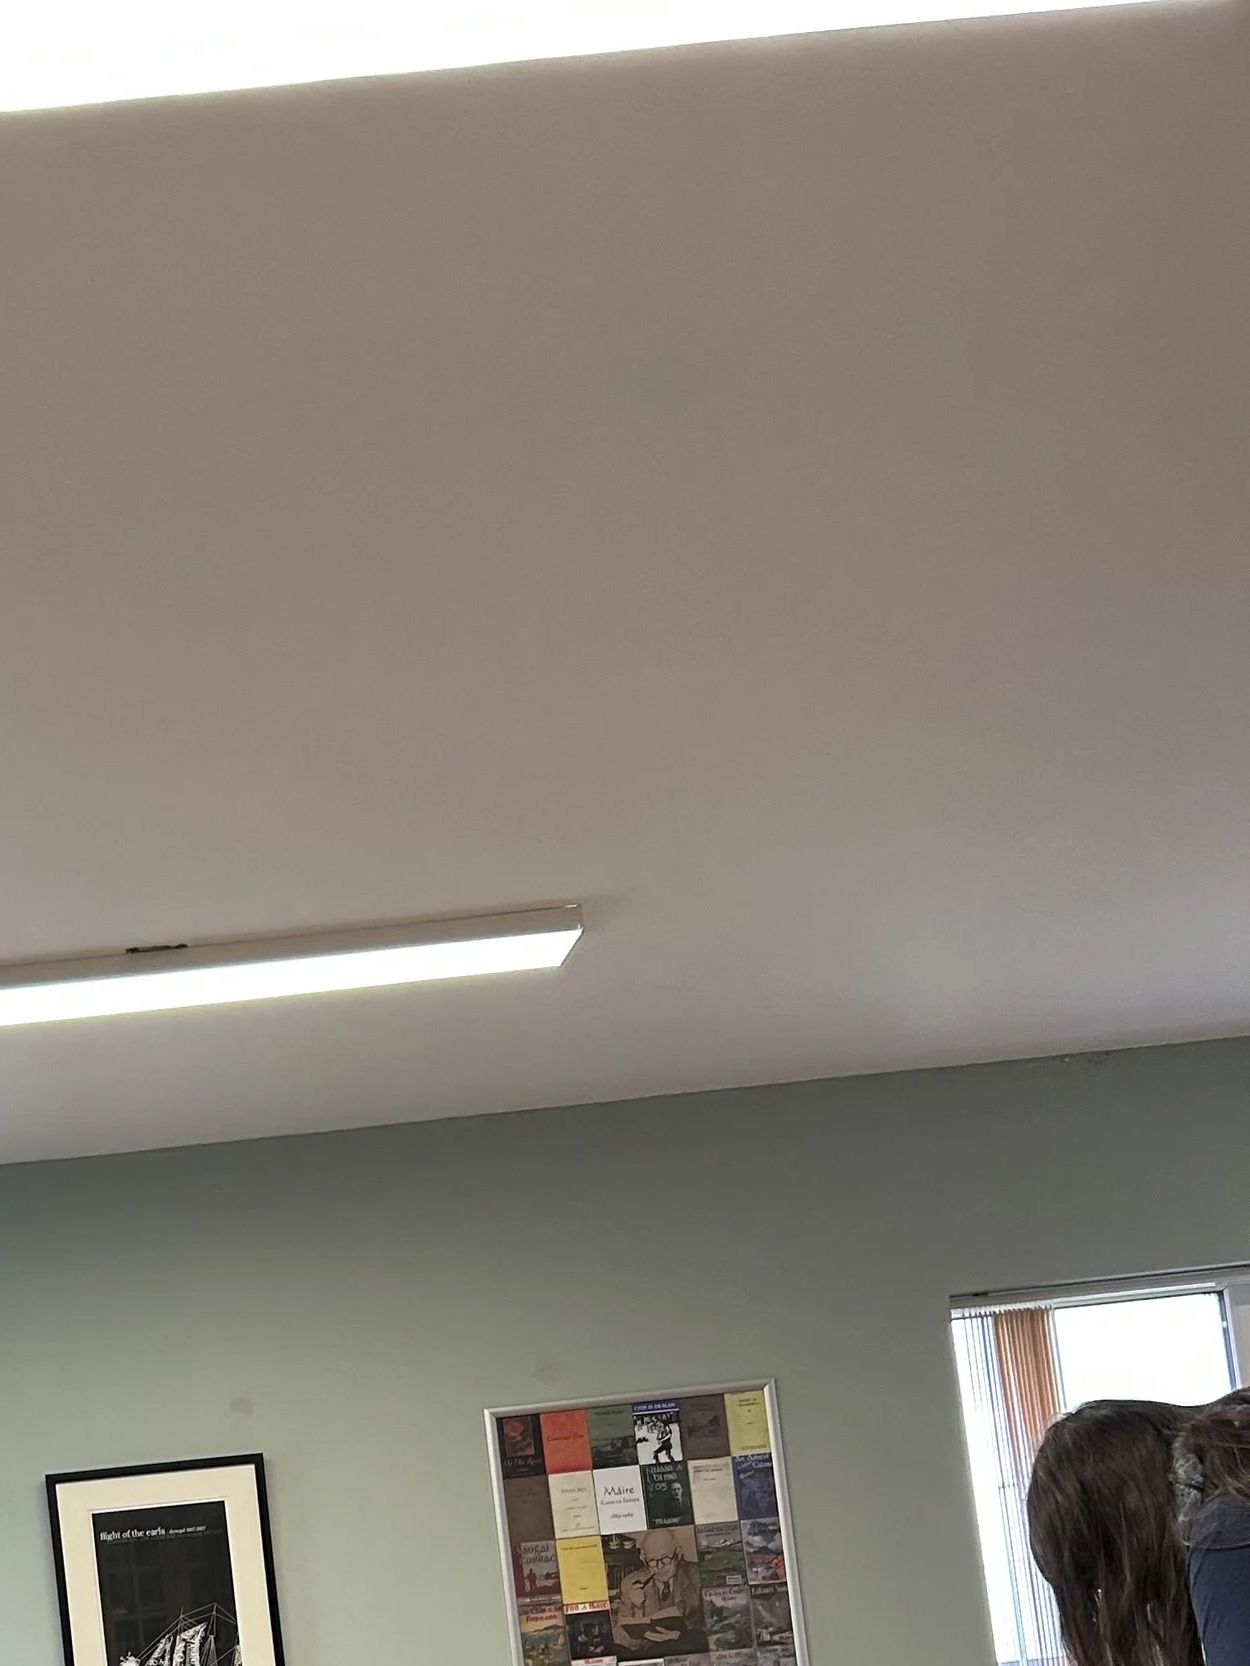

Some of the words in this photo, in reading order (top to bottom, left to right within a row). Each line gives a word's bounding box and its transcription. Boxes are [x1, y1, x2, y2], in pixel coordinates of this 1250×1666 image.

[603, 1485, 635, 1497] Máire
[99, 1530, 120, 1541] flight
[121, 1528, 131, 1538] of
[131, 1527, 145, 1538] the
[145, 1525, 166, 1537] earls
